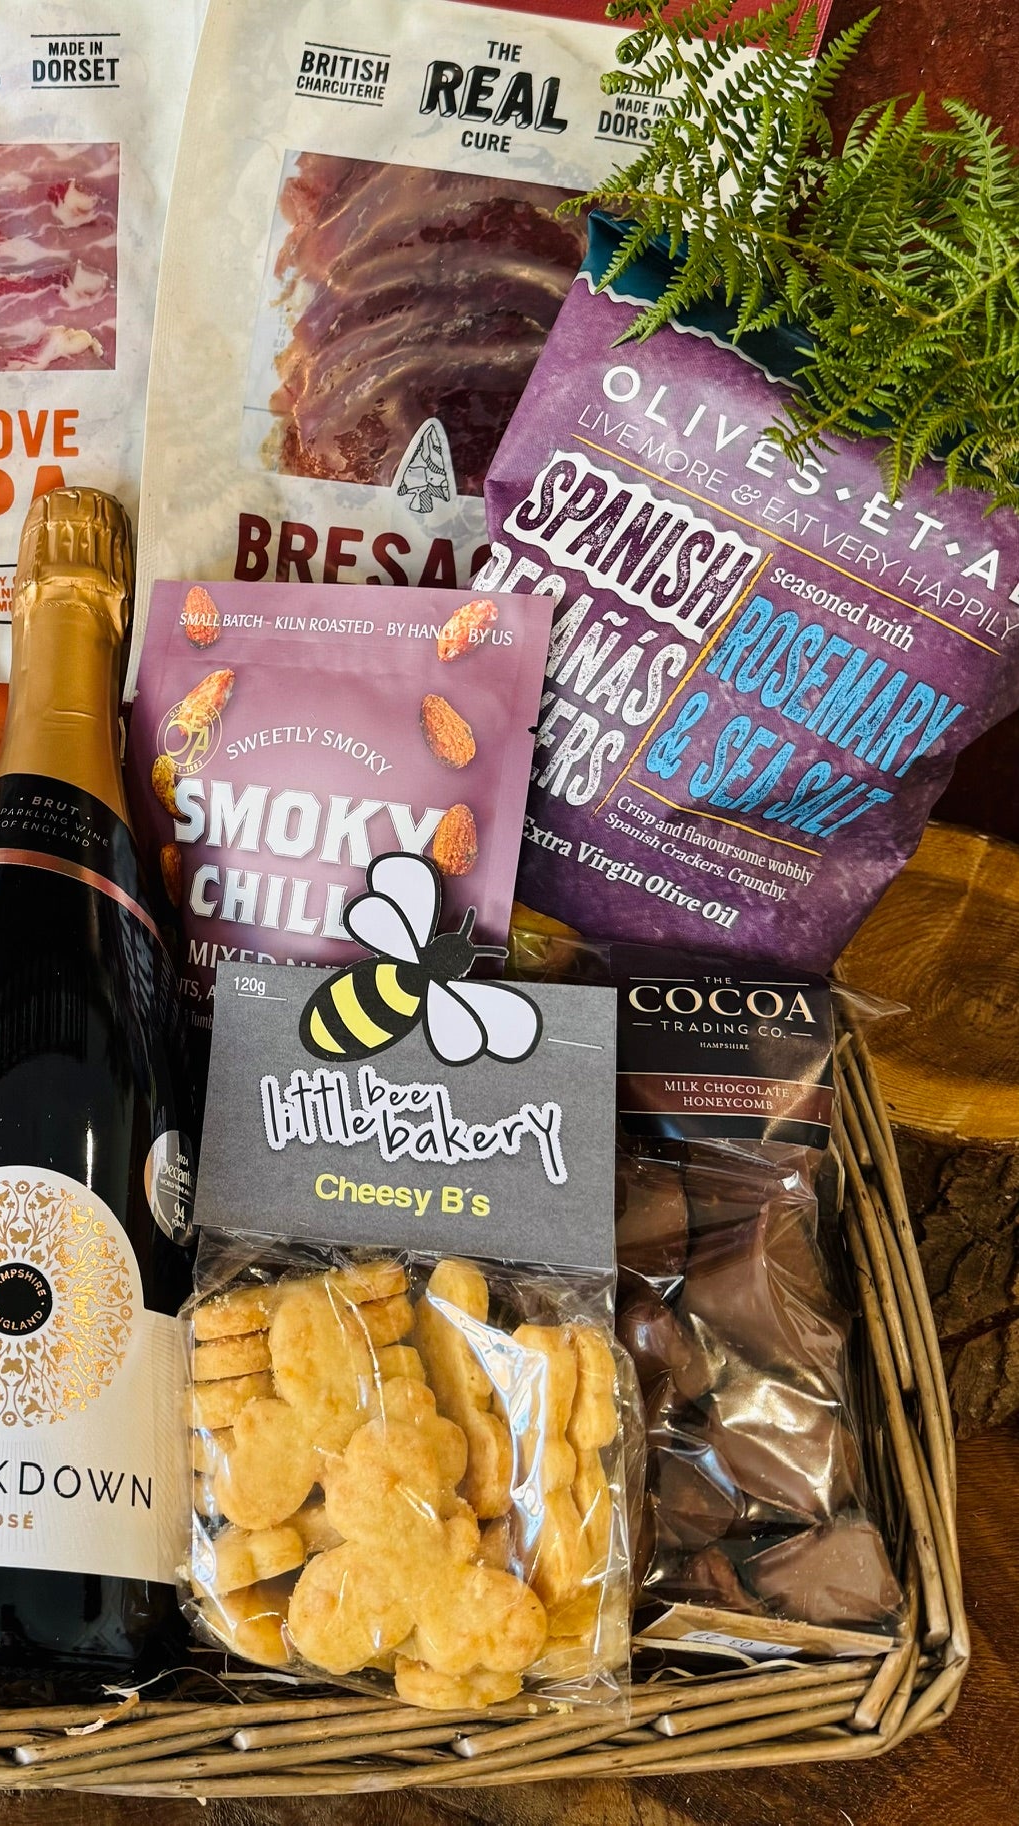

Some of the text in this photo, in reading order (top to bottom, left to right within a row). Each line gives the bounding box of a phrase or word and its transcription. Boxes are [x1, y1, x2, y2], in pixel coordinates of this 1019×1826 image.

[48, 42, 86, 57] MADE
[88, 42, 103, 55] IN
[486, 40, 522, 63] THE
[31, 58, 120, 83] DORSET
[300, 50, 389, 84] BRITISH
[419, 60, 568, 134] REAL
[615, 97, 650, 114] MADE
[461, 130, 512, 153] CURE
[577, 404, 1019, 641] LIVE MORE & EAT VERY HAPPILY
[515, 458, 755, 632] SPANISH
[769, 566, 915, 653] seasoned with
[705, 593, 965, 779] ROSEMARY
[225, 725, 319, 761] SWEETLY
[321, 730, 393, 776] SMOKY
[646, 690, 896, 840] & SEA SALT
[32, 796, 80, 816] BRUT
[174, 777, 445, 868] SMOKY
[1, 820, 90, 847] OF ENGLAND
[75, 822, 110, 847] WINE
[617, 795, 815, 887] Crisp and flavoursome wobbly
[522, 816, 740, 930] Extra Virgin Olive Oil
[604, 812, 787, 902] Spanish Crackers. Crunchy.
[233, 976, 266, 996] 120g
[704, 976, 732, 985] THE
[628, 985, 816, 1024] COCOA
[660, 1020, 787, 1039] TRADING CO.
[700, 1041, 750, 1050] HAMPSHIRE
[364, 1072, 430, 1107] bee
[664, 1080, 790, 1098] MILK CHOCOLATE
[683, 1096, 774, 1110] HONEYCOMB
[263, 1074, 560, 1180] little bakery
[315, 1173, 433, 1216] Cheesy
[174, 1203, 185, 1222] 94
